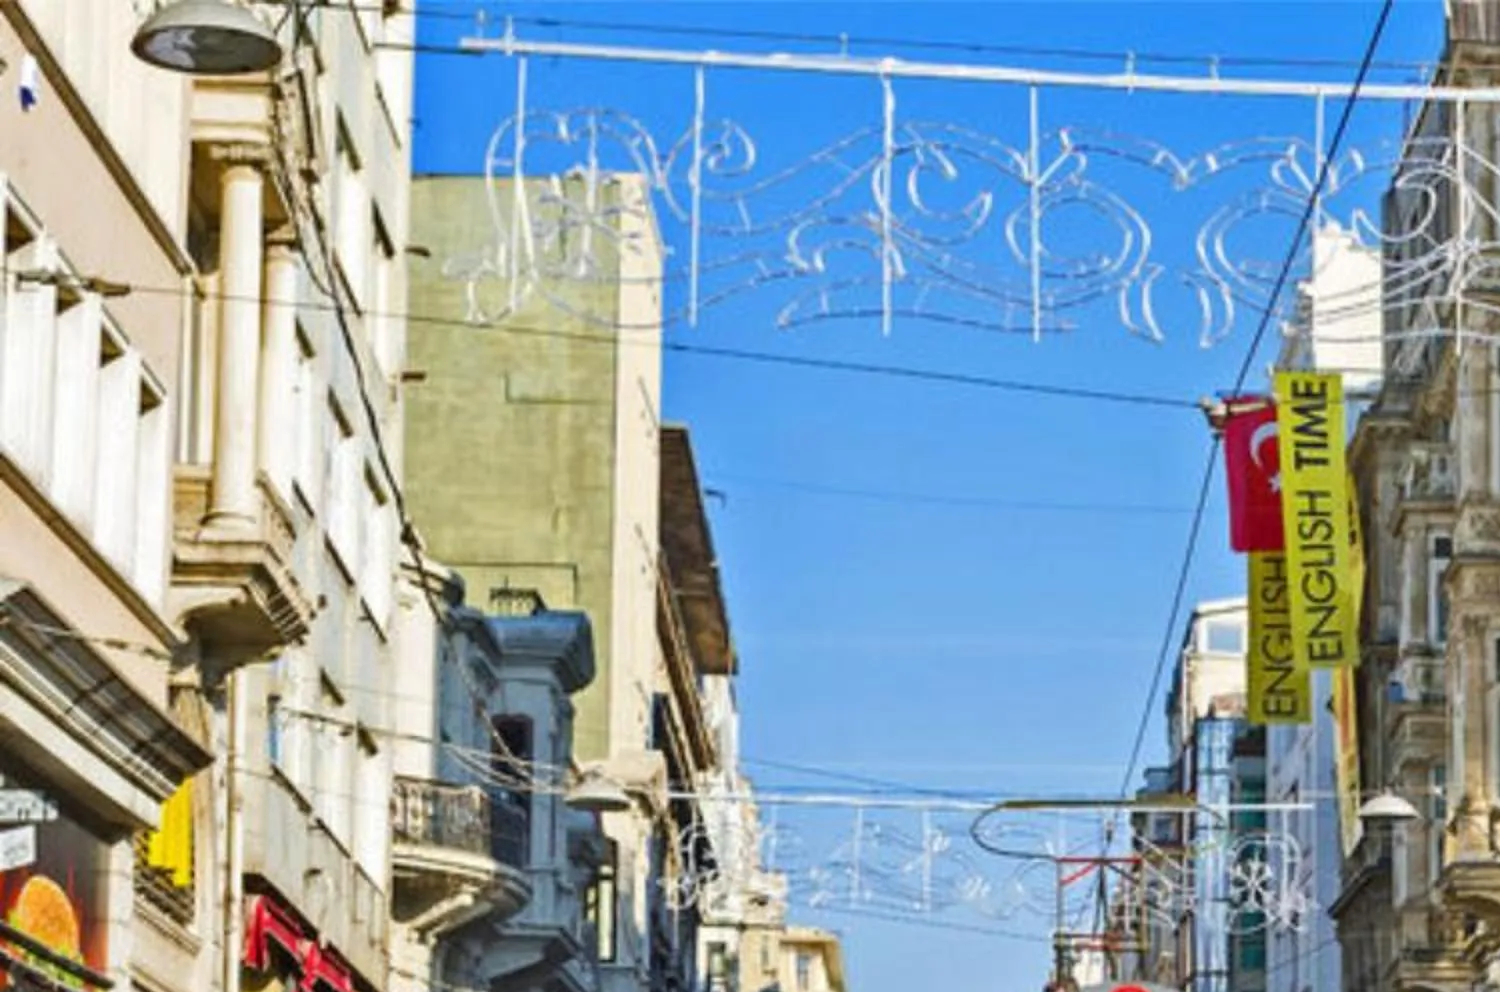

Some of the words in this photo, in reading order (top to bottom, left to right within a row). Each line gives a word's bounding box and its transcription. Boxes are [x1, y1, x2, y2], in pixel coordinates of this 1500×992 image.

[1291, 379, 1330, 472] TIME
[1261, 556, 1297, 718] ENGLISH
[1297, 490, 1344, 663] ENGLISH
